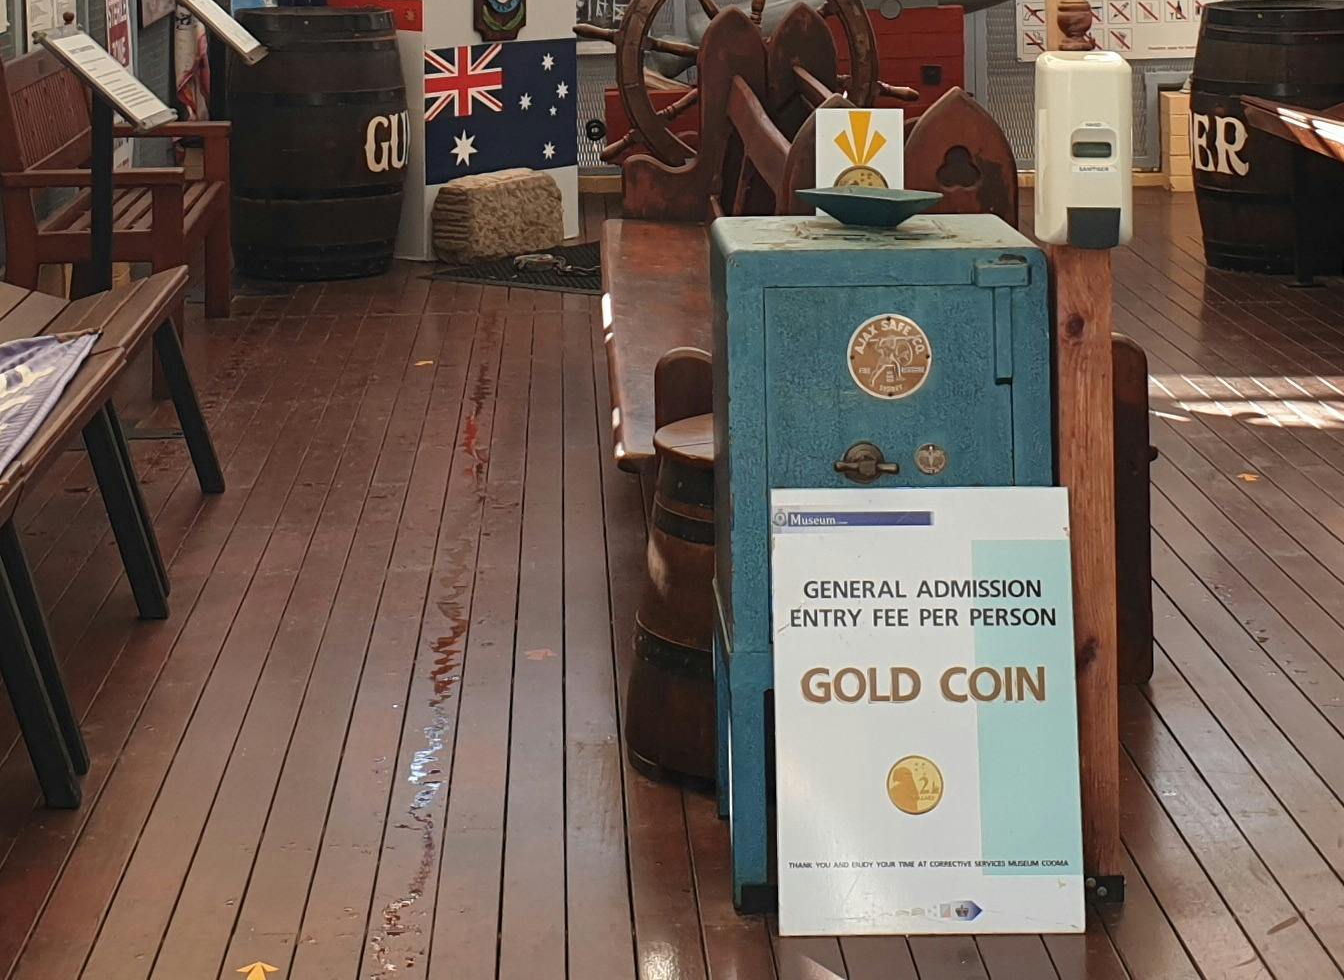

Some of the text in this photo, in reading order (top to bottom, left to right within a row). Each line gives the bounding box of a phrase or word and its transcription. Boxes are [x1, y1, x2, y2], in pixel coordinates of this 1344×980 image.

[364, 110, 411, 173] GU
[1189, 112, 1250, 176] ER
[854, 324, 879, 355] AJAX
[880, 319, 912, 336] SAFE
[791, 514, 838, 527] Museum
[804, 580, 1041, 598] GENERAL ADMISSION
[791, 608, 1056, 627] ENTRY FEE PER PERSON
[800, 667, 1045, 704] GOLD COIN
